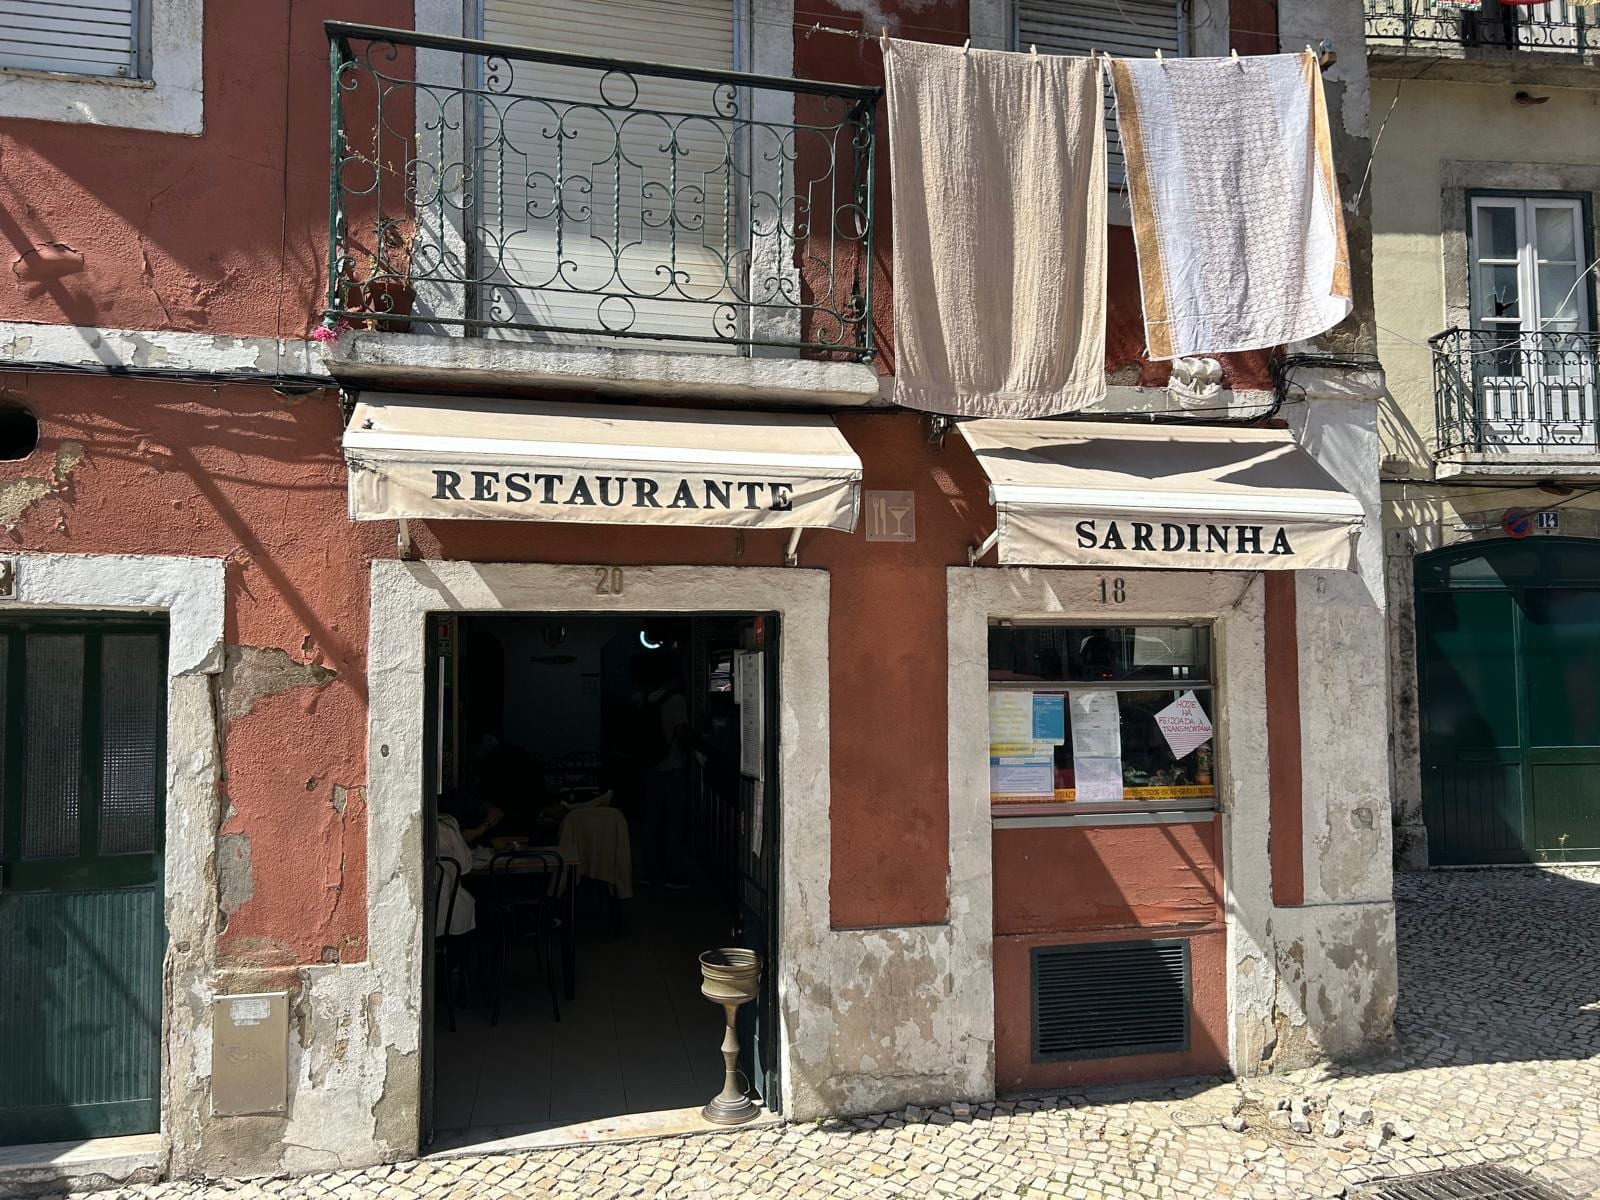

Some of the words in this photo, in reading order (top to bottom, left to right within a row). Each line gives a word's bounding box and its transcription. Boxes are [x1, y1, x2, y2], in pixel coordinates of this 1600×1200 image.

[432, 469, 793, 512] RESTAURANTE
[1542, 513, 1555, 528] 14
[1076, 520, 1295, 555] SARDINHA
[594, 567, 624, 595] 20
[1099, 577, 1126, 604] 18
